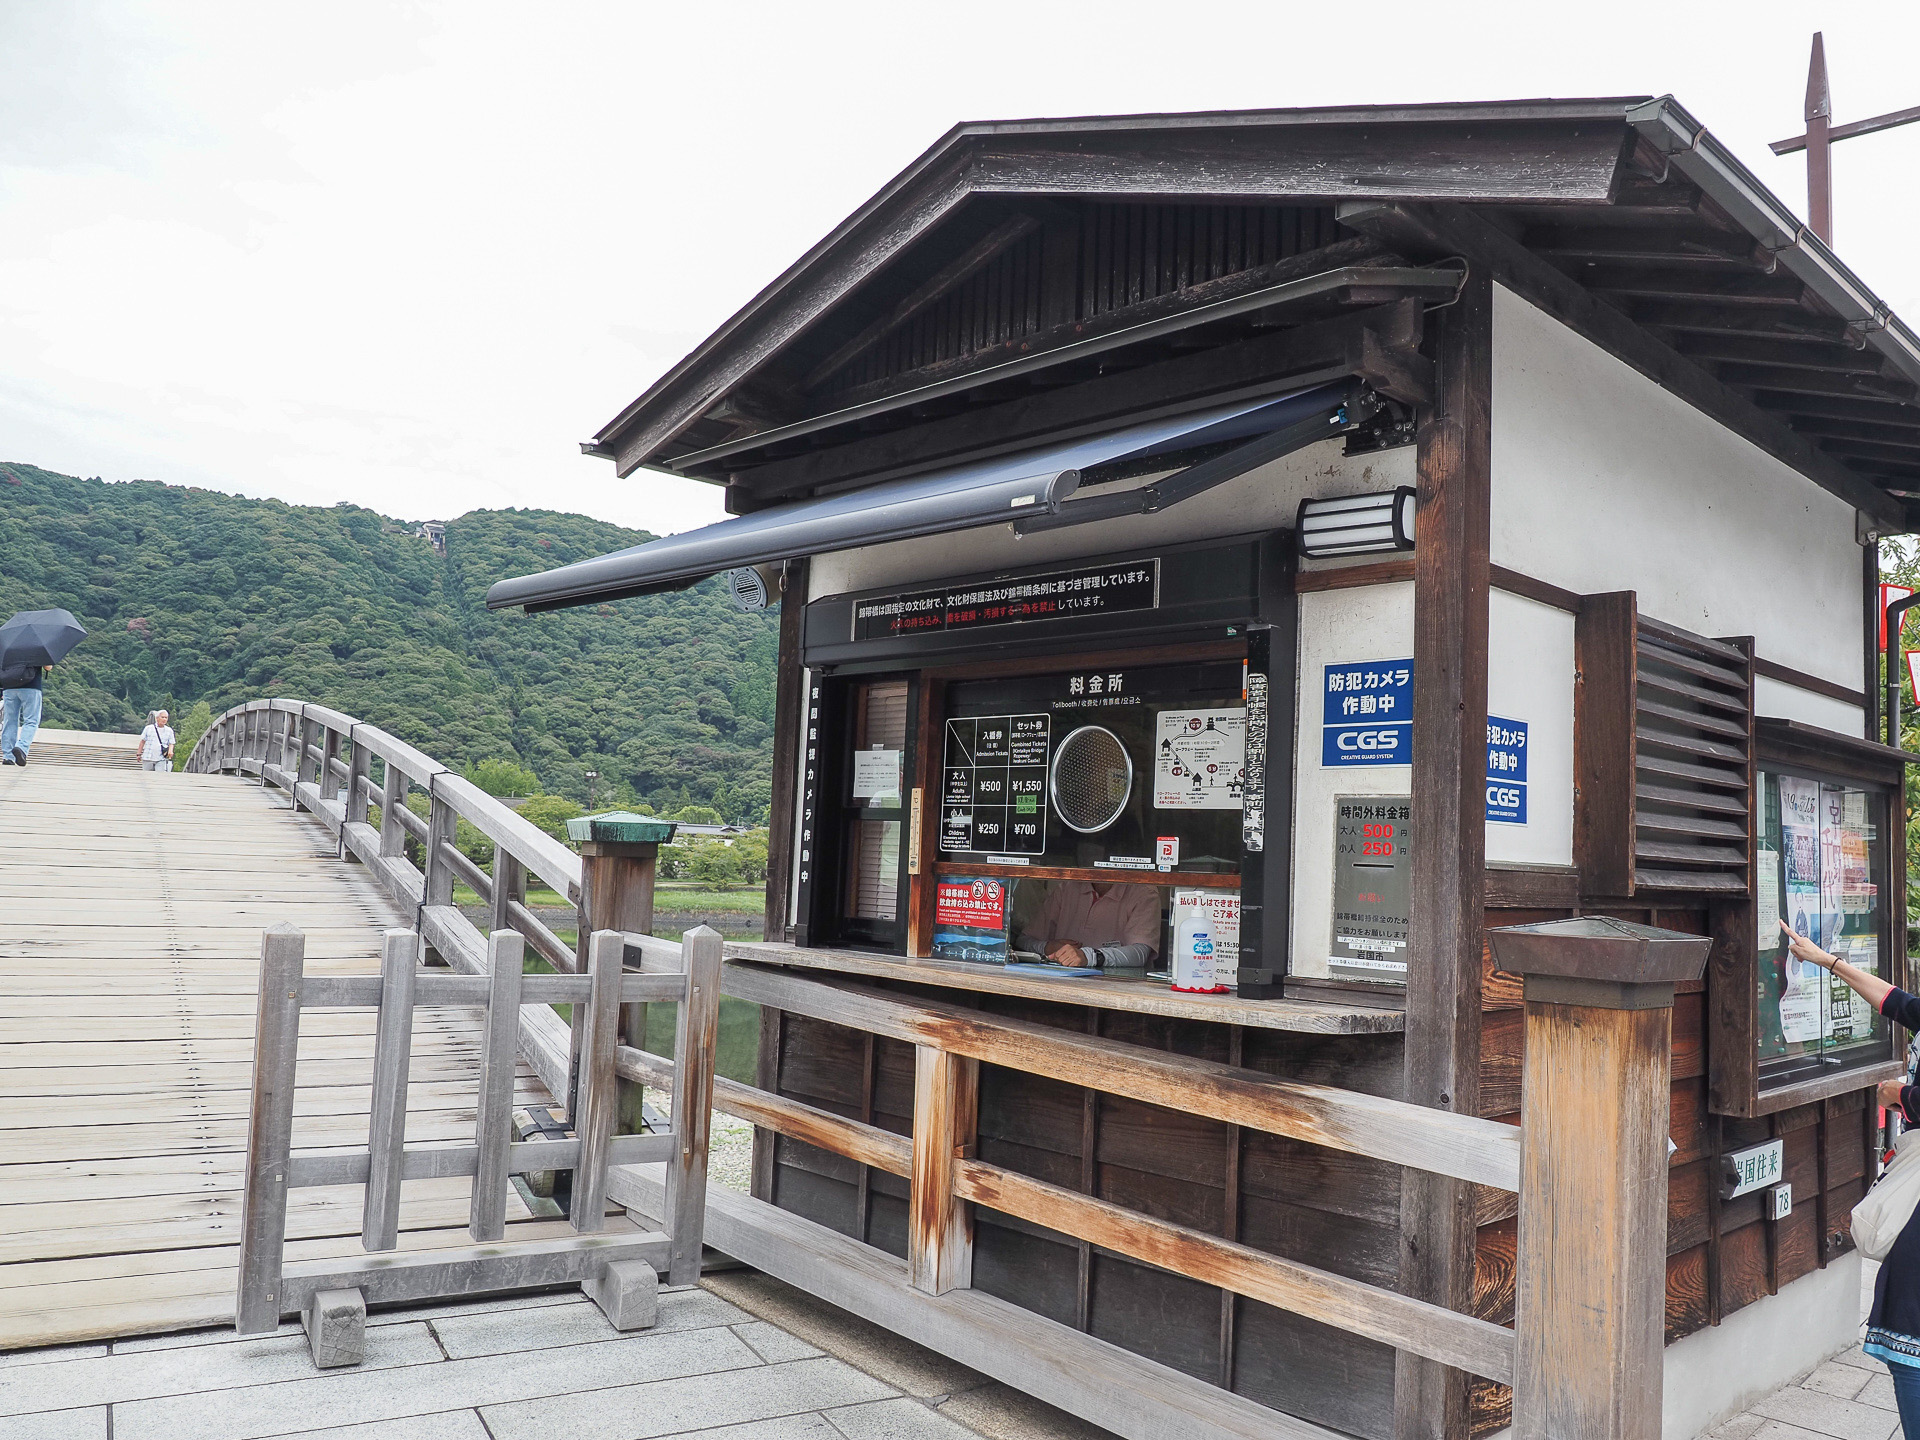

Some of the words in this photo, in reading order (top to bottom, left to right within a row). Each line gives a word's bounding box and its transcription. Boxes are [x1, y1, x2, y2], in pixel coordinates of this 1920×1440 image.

[1069, 673, 1123, 695] 料金所
[1328, 669, 1410, 692] 防犯カメラ
[1342, 693, 1395, 716] 作動中
[1016, 720, 1043, 730] セット券
[1336, 730, 1399, 751] CGS
[1488, 749, 1518, 772] 作動中
[952, 771, 966, 780] 大人
[980, 780, 1001, 792] ¥500
[1012, 780, 1042, 793] ¥1,550
[1486, 786, 1520, 808] CGS
[1340, 805, 1410, 820] 時間外料金箱
[978, 823, 999, 834] ¥250
[1014, 823, 1036, 835] ¥700
[1339, 826, 1357, 836] 大人
[1362, 824, 1393, 838] 500
[1400, 829, 1408, 837] 円
[1338, 843, 1356, 854] 小人
[1362, 842, 1393, 856] 250
[1399, 847, 1407, 856] 円
[1357, 892, 1385, 903] お願い
[939, 898, 1002, 911] 飲食持ち込み禁止です。
[1212, 909, 1239, 919] ご了承く
[1336, 912, 1409, 925] 錦帯橋維持保全のため
[1336, 926, 1408, 939] ご協力をお願いします
[1778, 1191, 1789, 1213] 78
